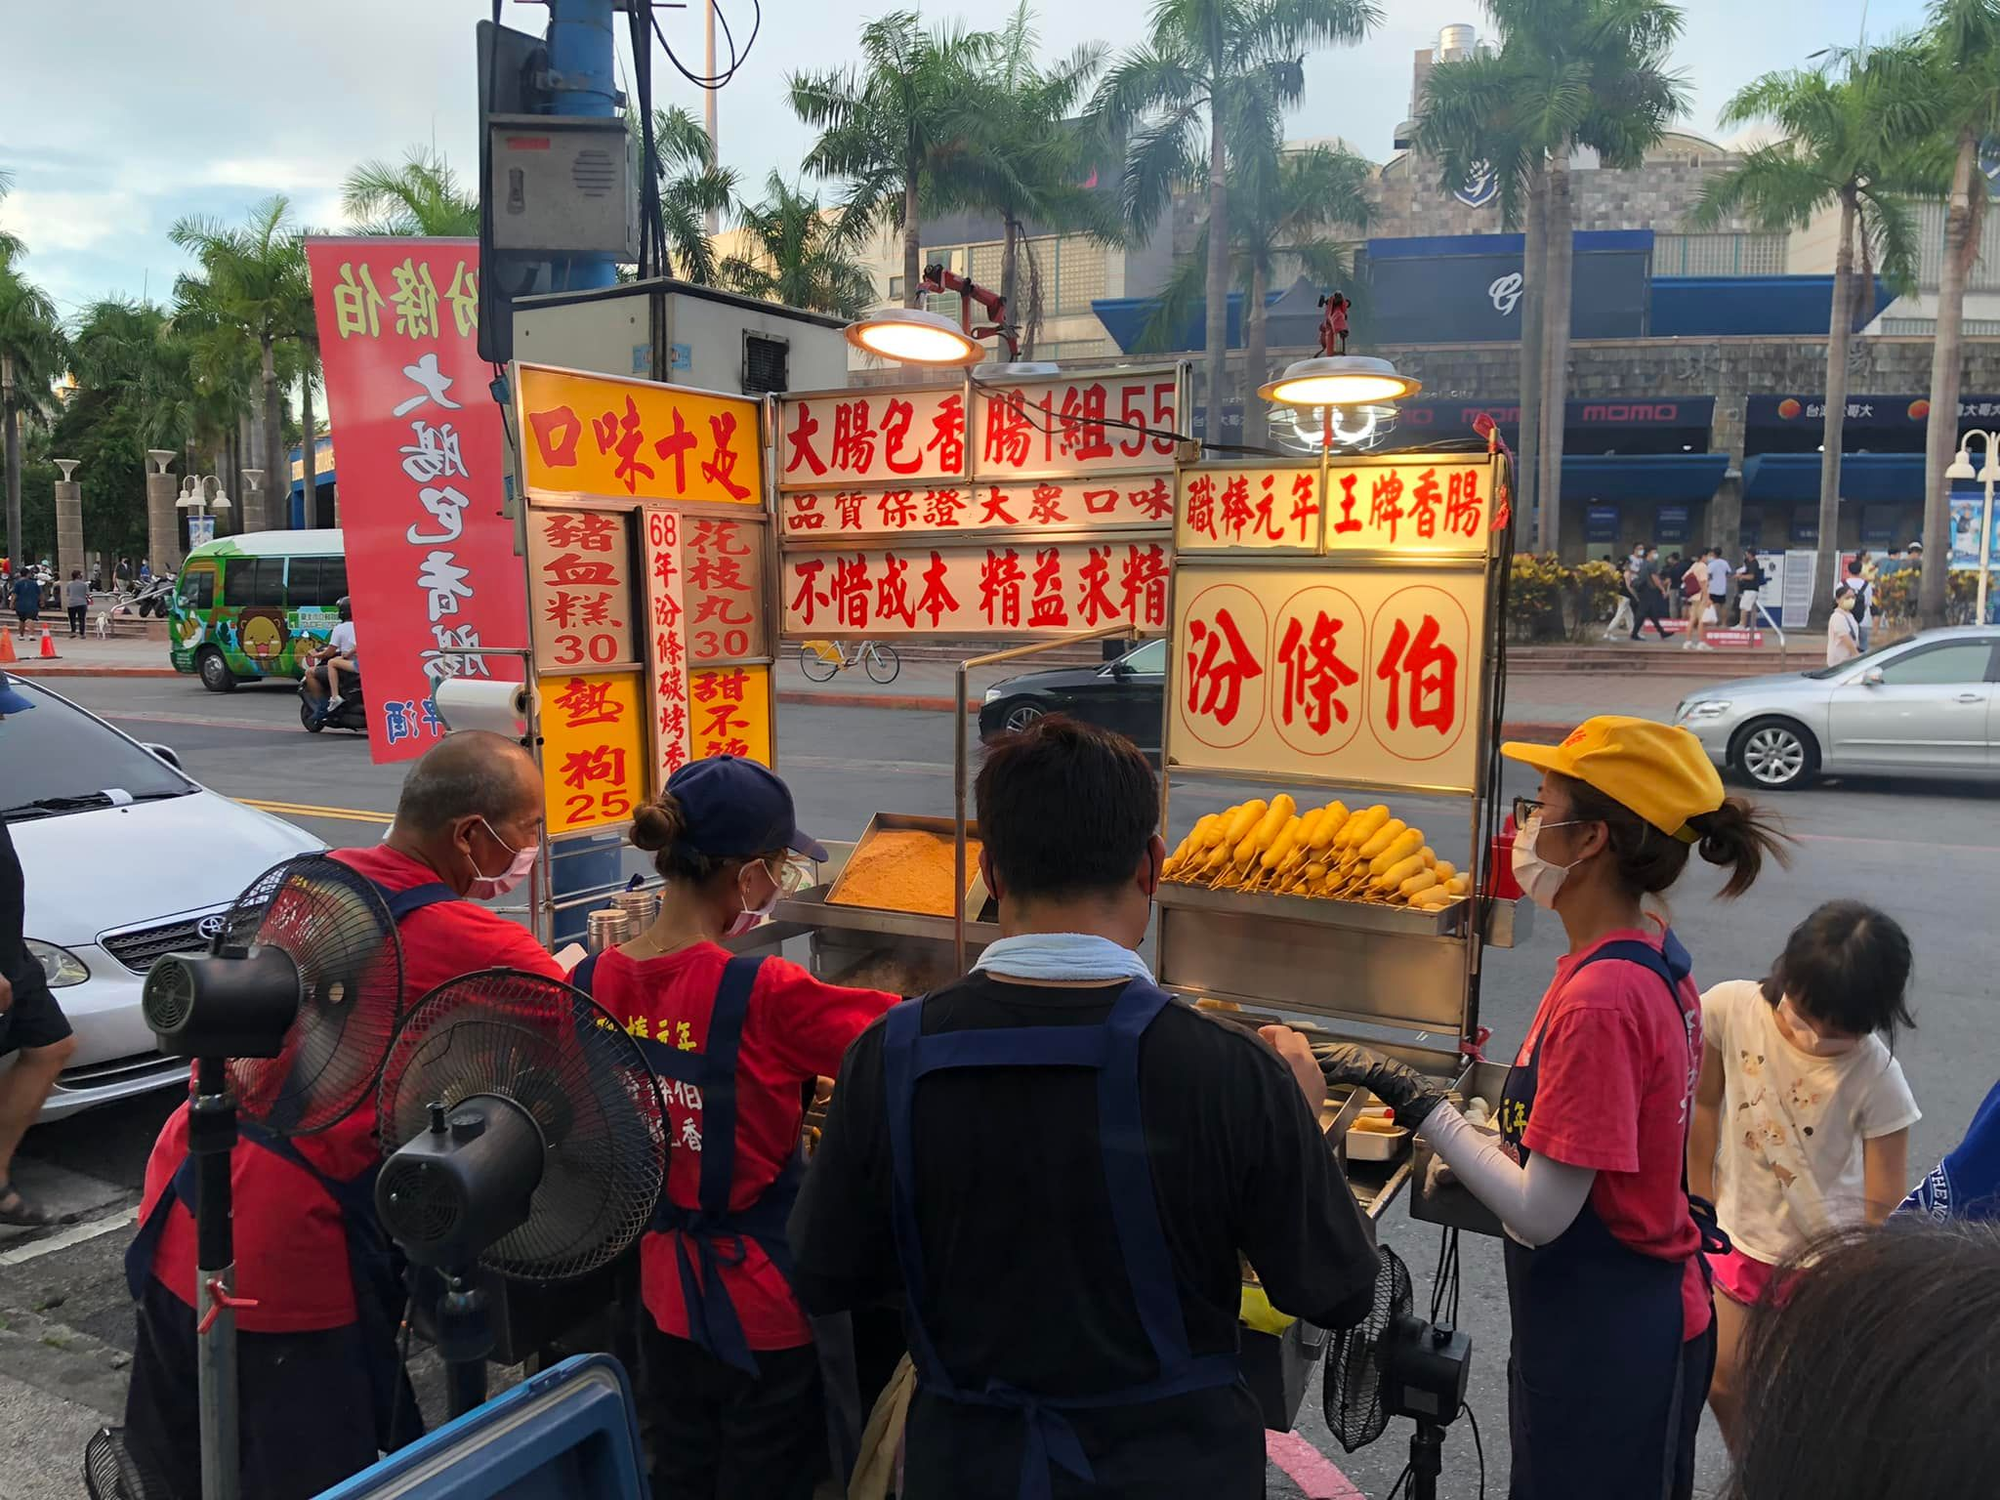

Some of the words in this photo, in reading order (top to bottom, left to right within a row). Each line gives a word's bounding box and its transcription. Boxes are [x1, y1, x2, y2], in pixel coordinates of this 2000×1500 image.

[529, 394, 751, 500] 口味十足
[1334, 468, 1483, 543] 王牌香腸
[687, 520, 754, 625] 花枝丸
[791, 551, 960, 629] 不惜成本
[979, 543, 1171, 629] 精益求精
[553, 633, 618, 665] 30
[694, 629, 749, 659] 30
[1187, 608, 1458, 736] 汾條伯
[565, 790, 630, 825] 25
